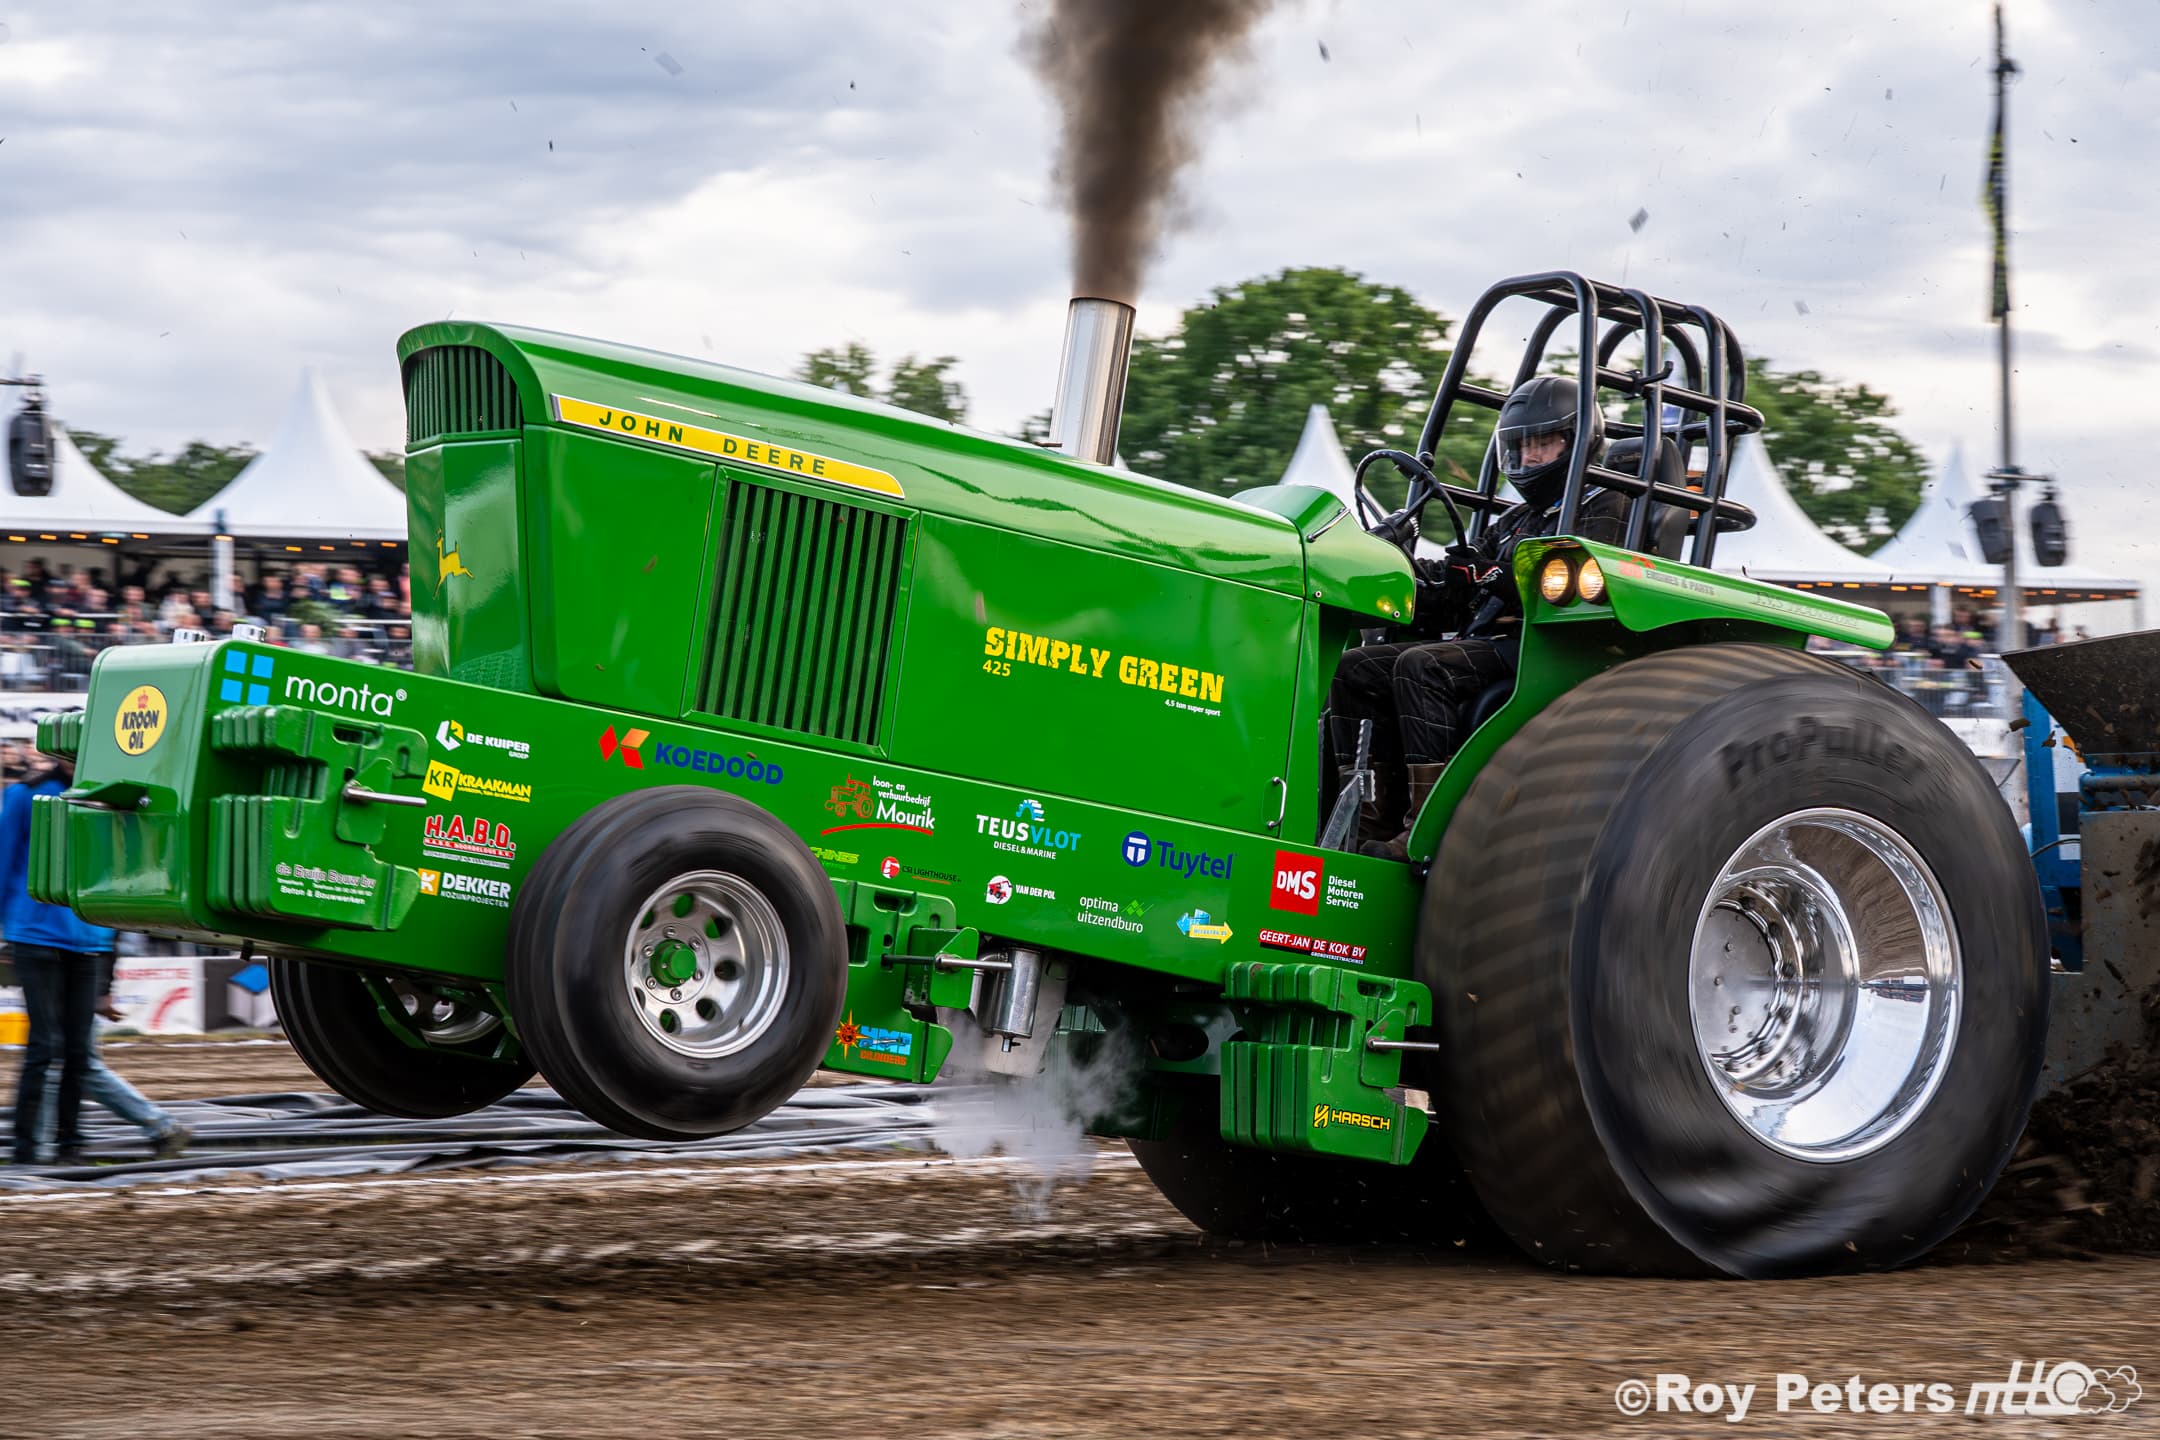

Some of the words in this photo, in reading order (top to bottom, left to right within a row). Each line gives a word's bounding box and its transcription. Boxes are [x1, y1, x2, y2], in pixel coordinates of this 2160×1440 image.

[599, 411, 684, 443] JOHN
[723, 437, 826, 476] DEERE
[982, 659, 1012, 678] 425
[984, 626, 1111, 679] SIMPLY
[1118, 655, 1225, 704] GREEN
[121, 709, 160, 730] KROON
[1176, 701, 1187, 709] ton
[1187, 704, 1204, 713] super
[1205, 708, 1221, 717] sport
[128, 730, 145, 750] OIL
[466, 731, 484, 745] DE
[485, 735, 530, 754] KUIPER
[654, 741, 785, 786] KOEDOOD
[428, 769, 454, 789] KR
[458, 773, 532, 798] KRAAKMAN
[872, 775, 894, 789] loon-
[895, 782, 906, 792] en
[877, 789, 932, 808] verhuurbedrijf
[876, 799, 936, 830] Mourik
[1156, 840, 1234, 880] Tuytel
[914, 867, 958, 882] LIGHTHOUSE
[1276, 870, 1317, 900] DMS
[1328, 875, 1357, 889] Diesel
[441, 871, 511, 900] DEKKER
[1015, 884, 1029, 895] VAN
[1029, 887, 1042, 898] DER
[1043, 890, 1056, 900] POL
[1327, 886, 1364, 900] Motoren
[1079, 896, 1119, 914] optima
[1325, 896, 1360, 910] Service
[1077, 909, 1144, 934] uitzendburo
[1259, 930, 1311, 949] GEERT-JAN
[1313, 939, 1327, 951] DE
[1328, 942, 1350, 956] KOK
[1351, 946, 1366, 958] BV
[1331, 1109, 1391, 1131] HARSCH
